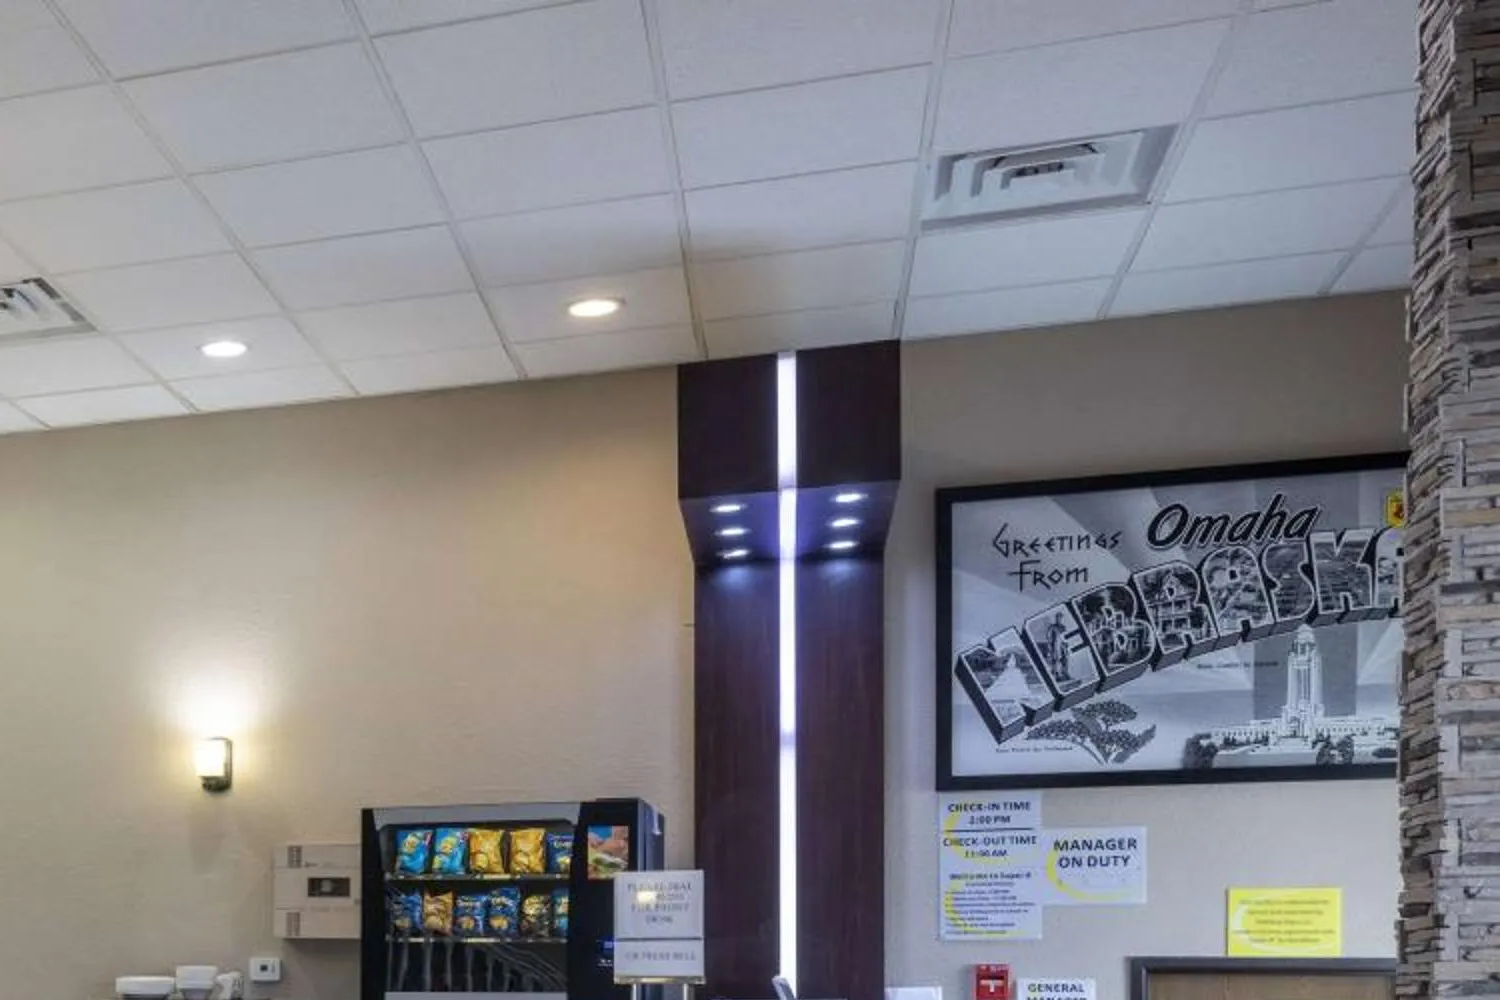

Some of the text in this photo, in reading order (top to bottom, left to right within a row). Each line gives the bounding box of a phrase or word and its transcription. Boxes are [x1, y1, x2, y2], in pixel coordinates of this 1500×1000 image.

[1146, 493, 1319, 548] Omaha
[947, 801, 1031, 813] CHECK-IN TIME
[993, 814, 1011, 824] PM
[943, 835, 1037, 847] CHECK-OUT TIME
[1053, 838, 1137, 851] MANAGER
[1058, 855, 1131, 868] ON DUTY
[1027, 983, 1085, 993] GENERAL
